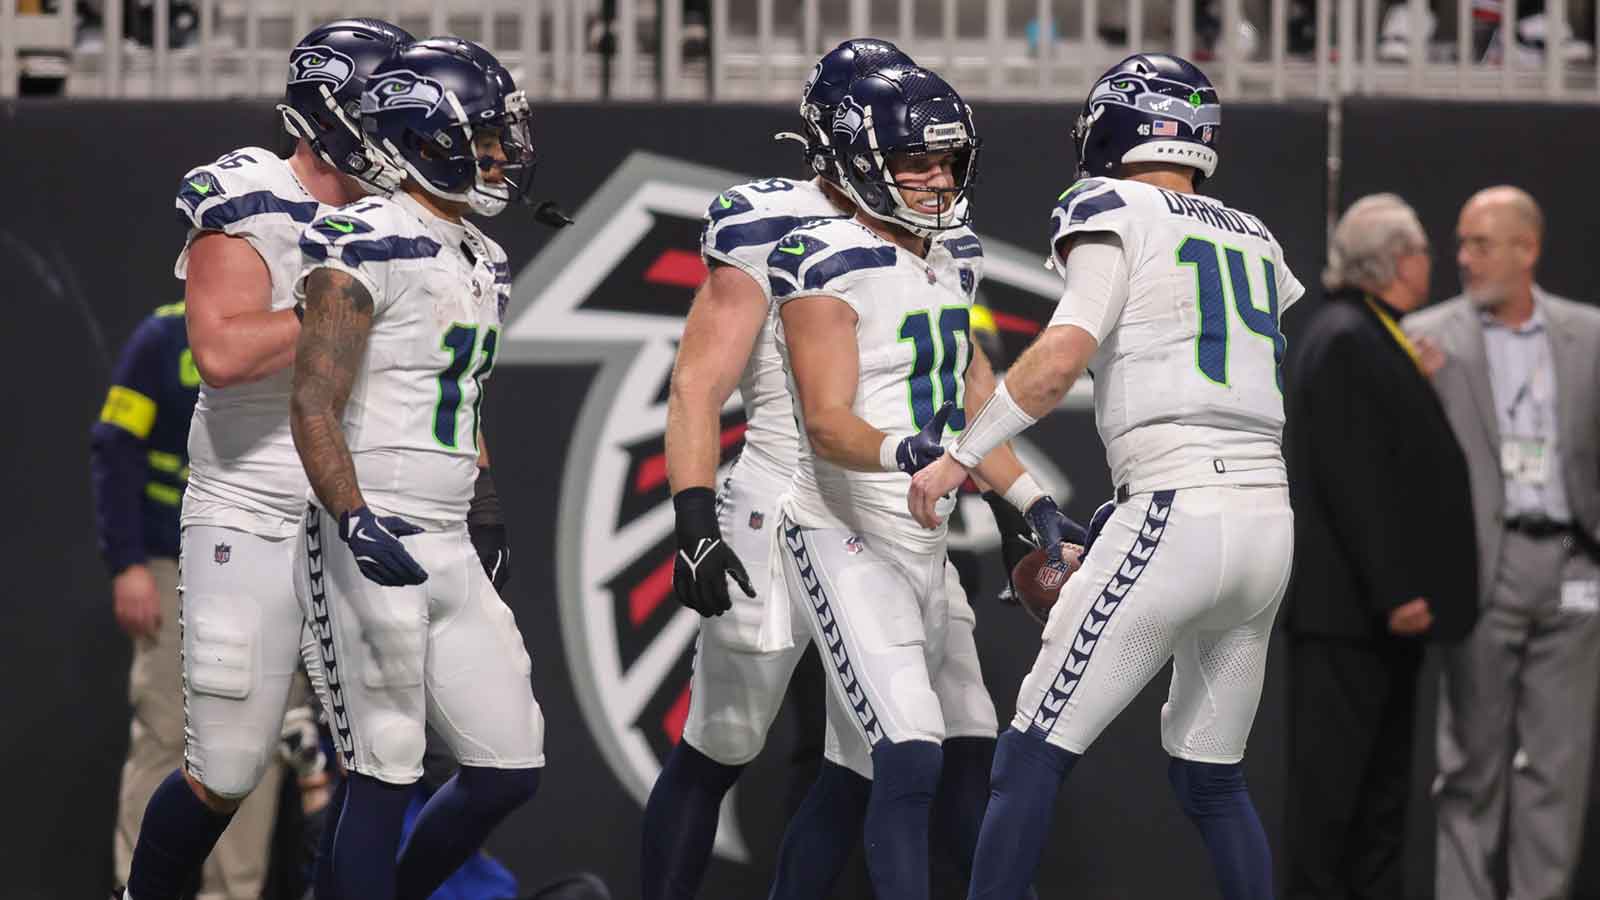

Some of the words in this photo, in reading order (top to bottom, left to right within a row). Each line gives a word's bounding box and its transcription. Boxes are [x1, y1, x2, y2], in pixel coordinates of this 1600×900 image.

[1137, 124, 1151, 136] 45
[1175, 233, 1287, 402] 14
[897, 304, 974, 436] 10
[1040, 567, 1063, 586] NFL
